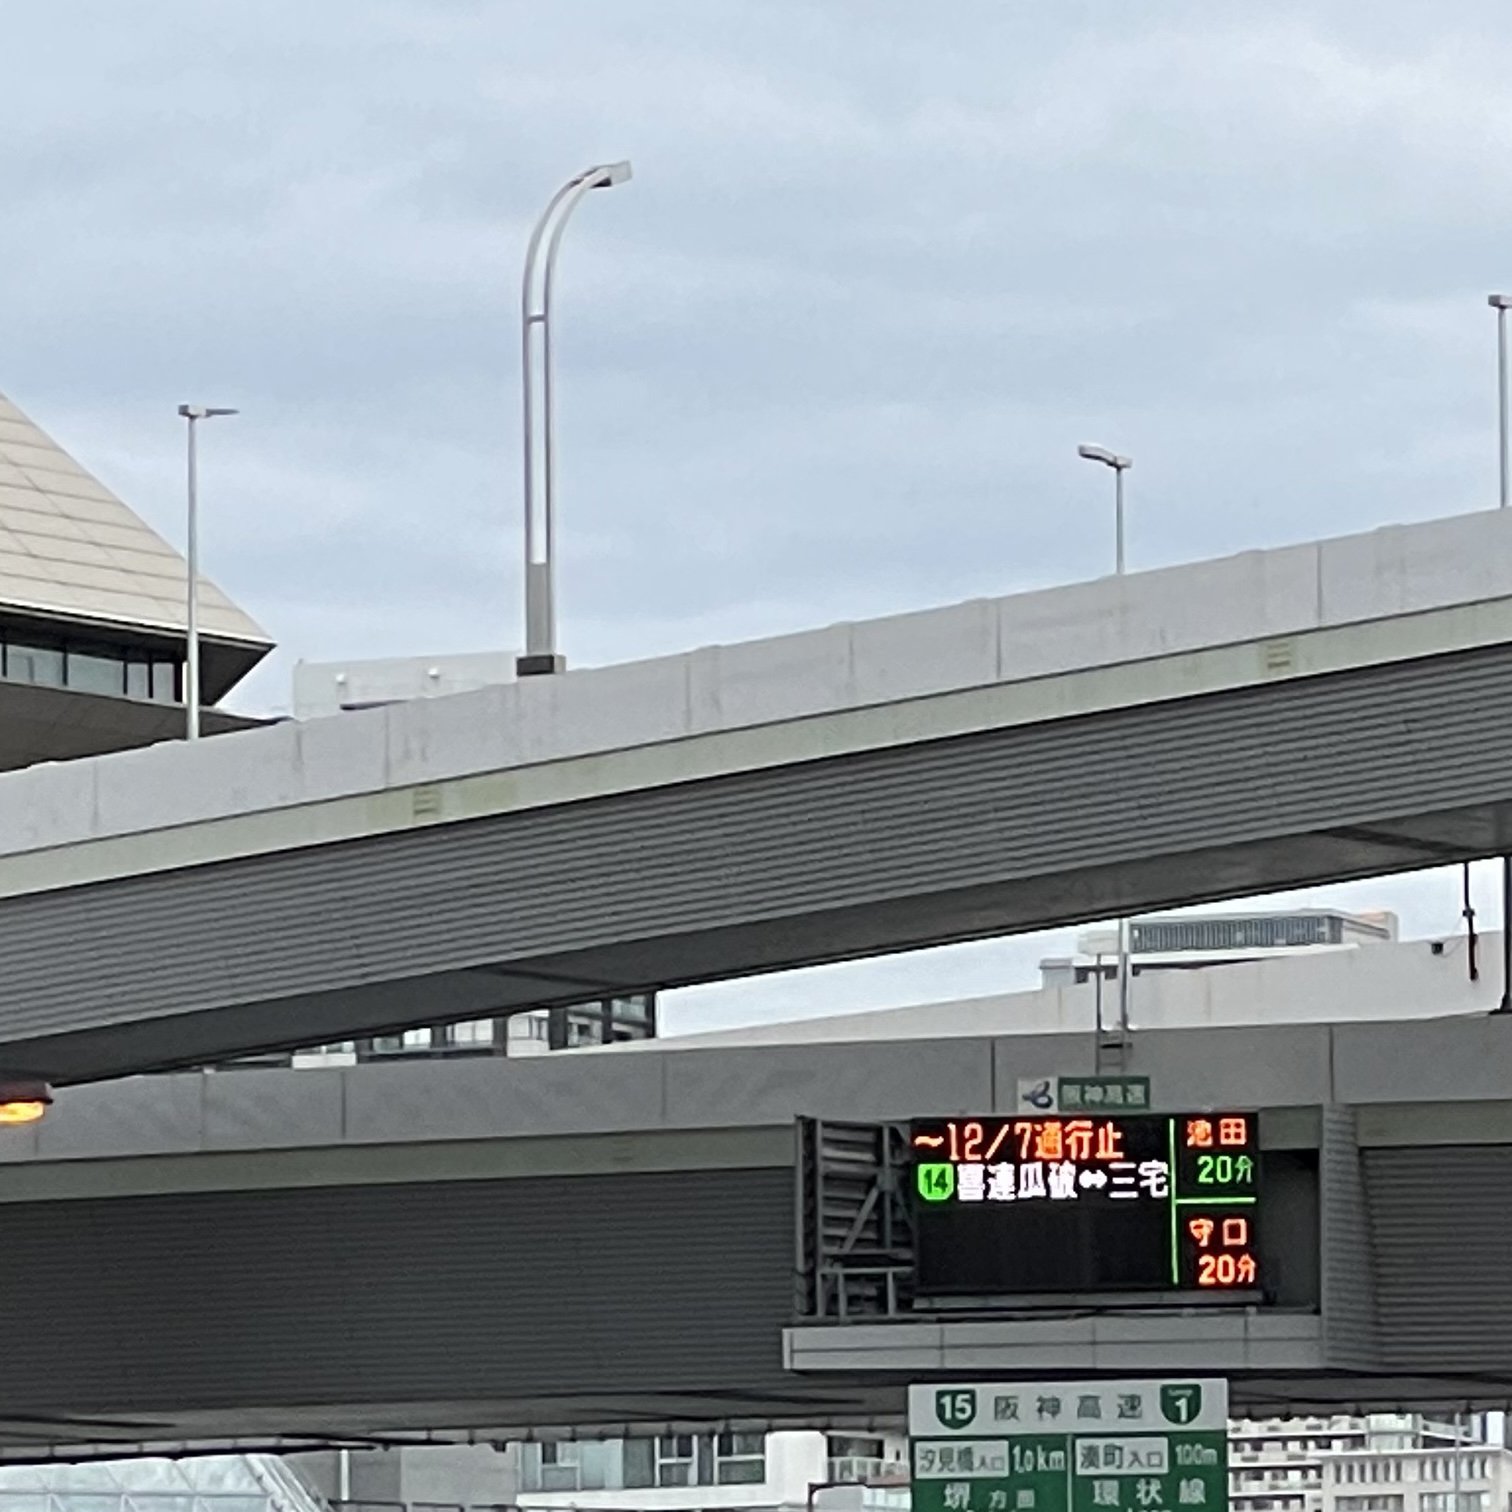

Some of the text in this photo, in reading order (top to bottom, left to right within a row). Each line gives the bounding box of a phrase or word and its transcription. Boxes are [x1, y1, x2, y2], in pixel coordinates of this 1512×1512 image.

[1197, 1155, 1255, 1184] 20分
[1189, 1219, 1248, 1247] 守口
[1198, 1255, 1256, 1284] 20分
[940, 1394, 973, 1421] 15
[994, 1393, 1143, 1421] 阪神高速
[1174, 1398, 1188, 1423] 1
